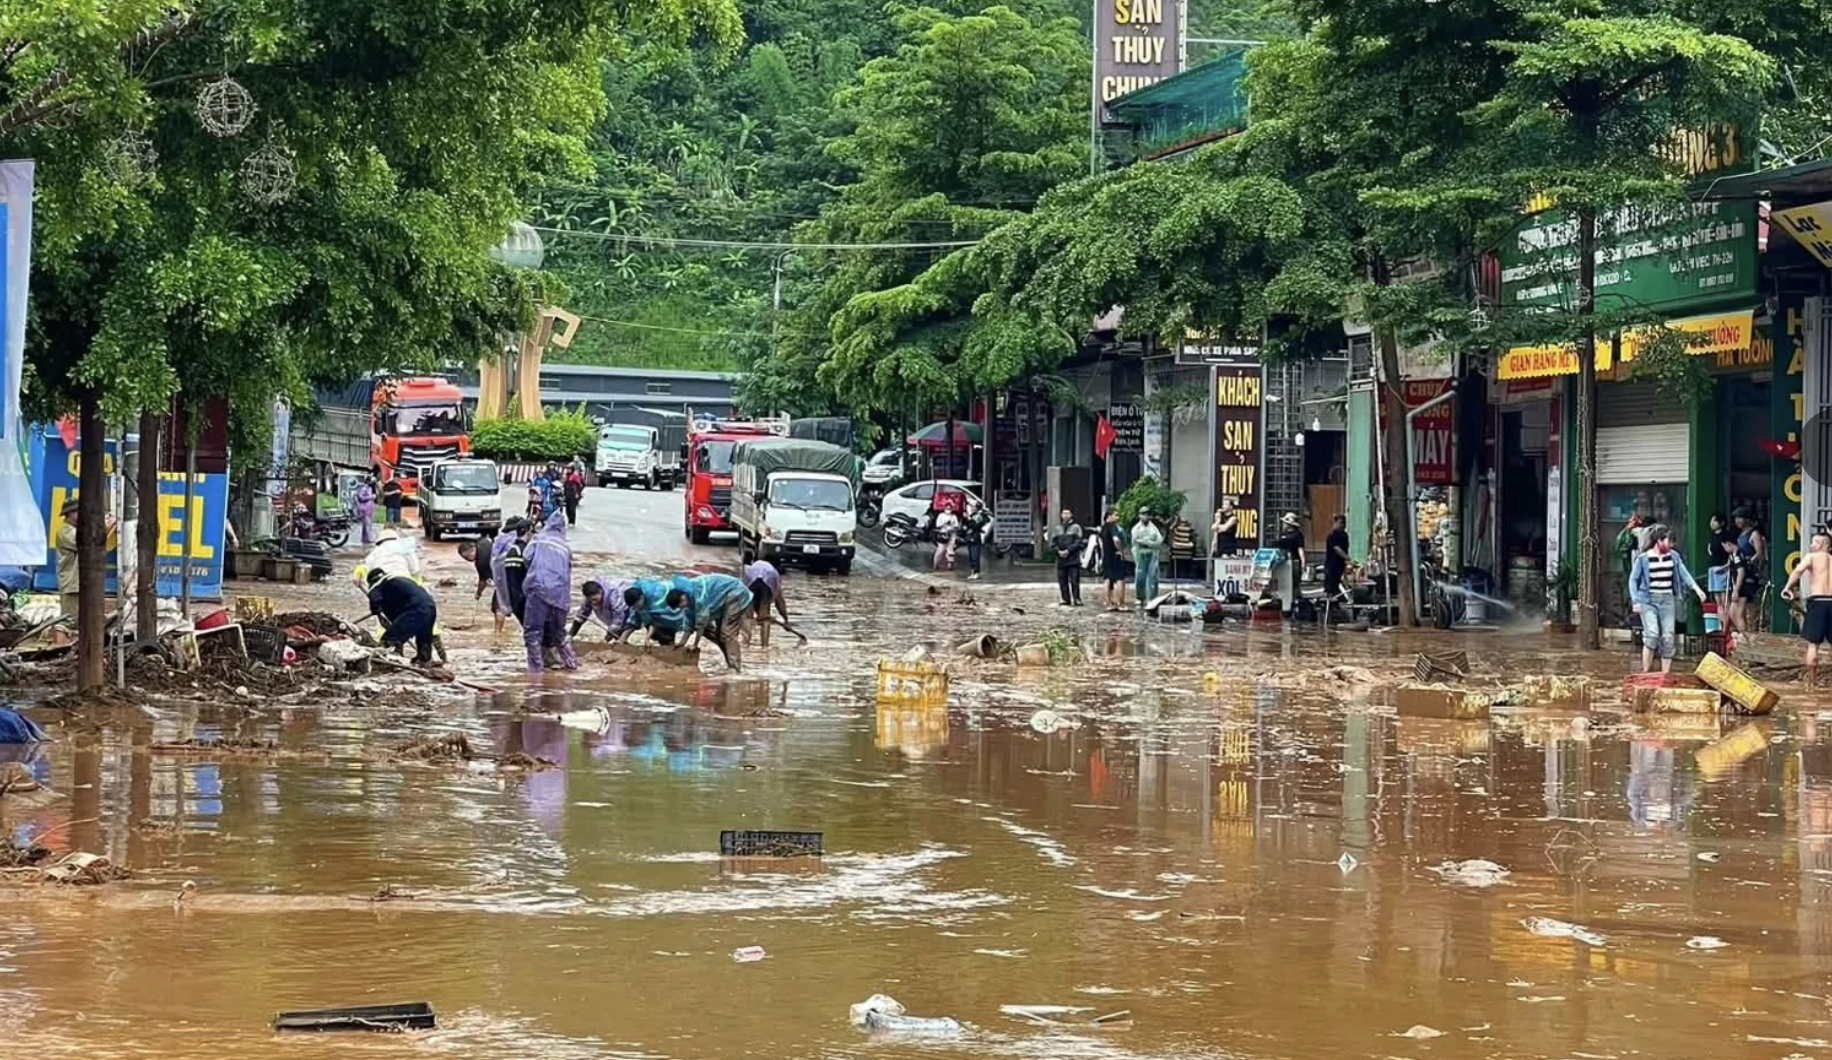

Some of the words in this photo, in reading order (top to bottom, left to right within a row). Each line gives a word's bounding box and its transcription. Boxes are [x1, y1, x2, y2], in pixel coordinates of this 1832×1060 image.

[1111, 26, 1166, 63] THỦY
[1510, 353, 1532, 372] GIAN
[1217, 370, 1261, 406] KHÁCH
[1223, 420, 1253, 456] SẠN
[1221, 454, 1255, 494] THỦY
